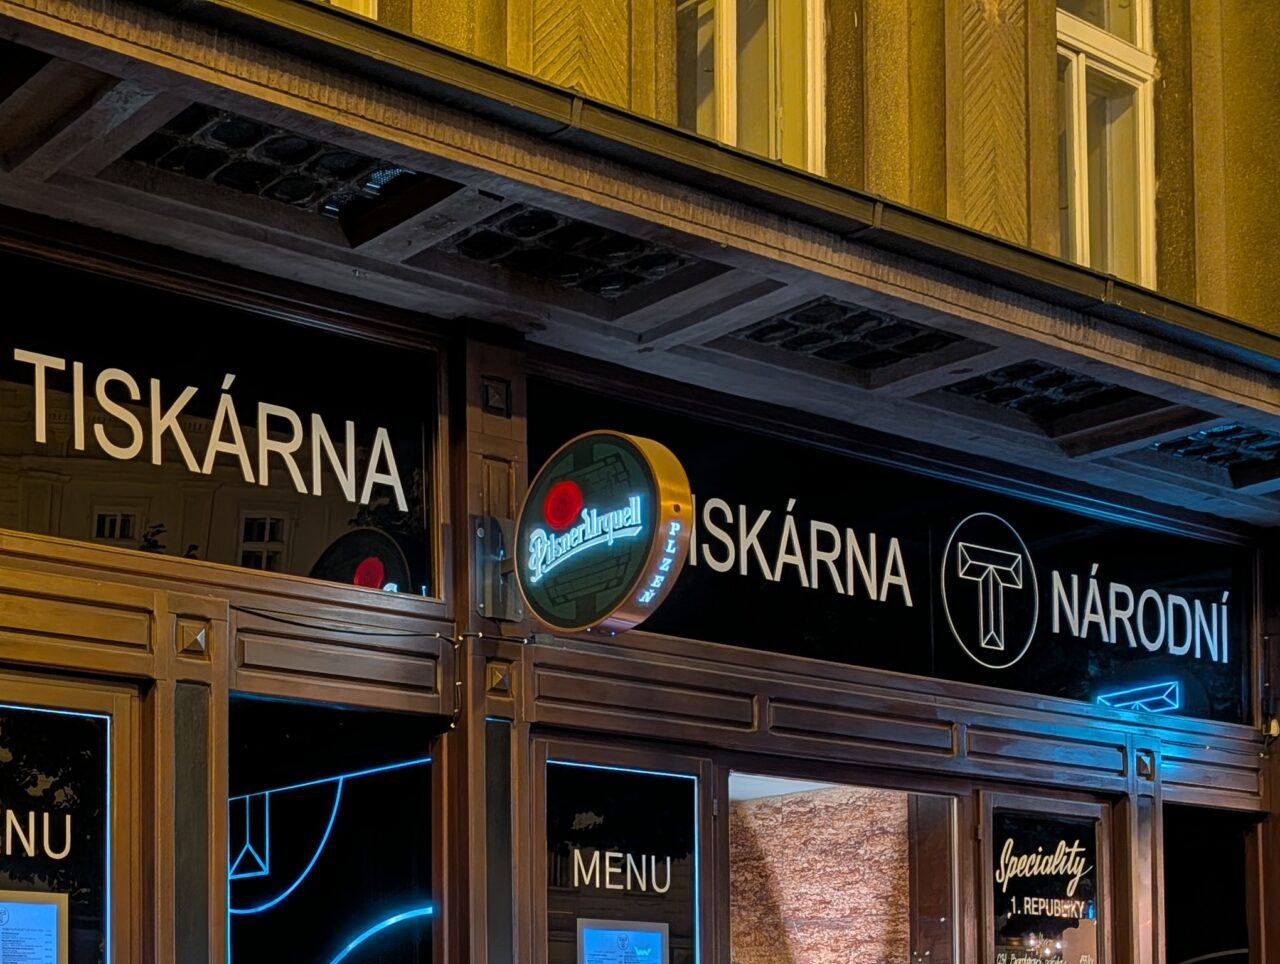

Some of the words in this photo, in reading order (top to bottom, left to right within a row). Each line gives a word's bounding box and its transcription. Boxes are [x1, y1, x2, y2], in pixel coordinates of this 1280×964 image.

[14, 348, 409, 513] TISKÁRNA
[528, 518, 585, 583] Pilsner
[582, 496, 641, 545] Urquell
[689, 494, 913, 607] ISKÁRNA
[1051, 563, 1229, 663] NÁRODNÍ
[574, 849, 670, 893] MENU
[995, 838, 1093, 897] Speciality
[1011, 896, 1021, 914] 1.
